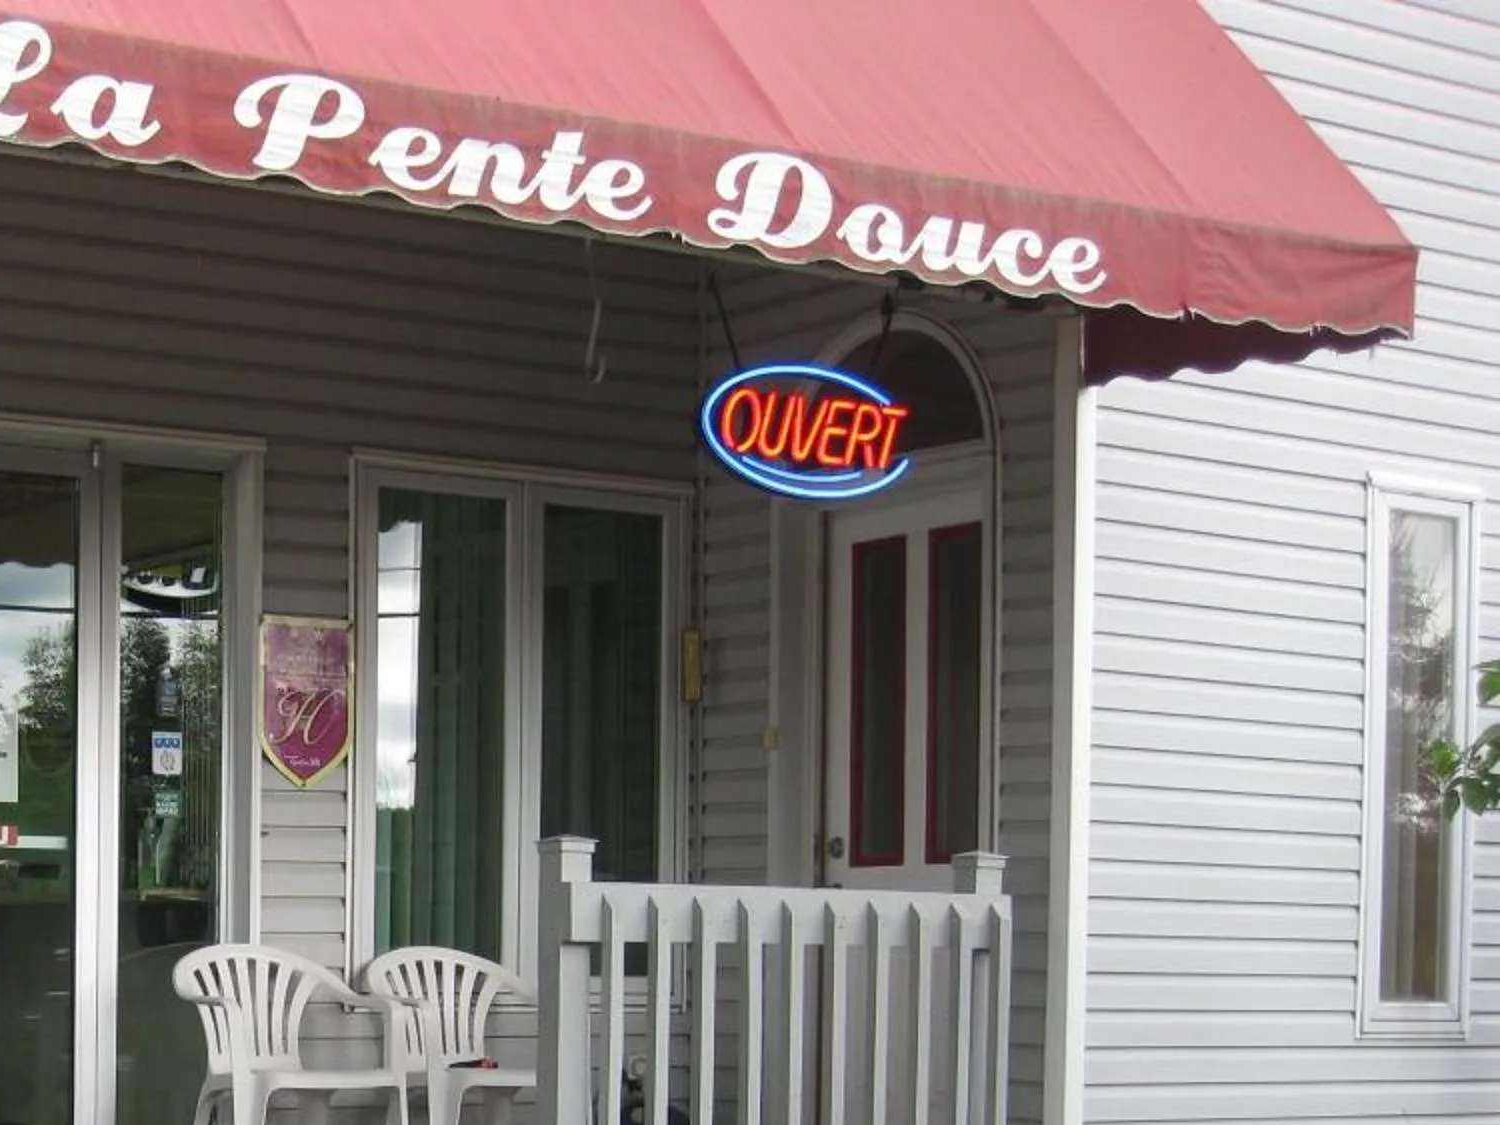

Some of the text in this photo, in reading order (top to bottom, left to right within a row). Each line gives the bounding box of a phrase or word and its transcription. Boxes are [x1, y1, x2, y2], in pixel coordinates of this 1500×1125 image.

[233, 73, 653, 221] Pente
[707, 151, 1107, 294] Douce
[720, 387, 908, 469] OUVERT
